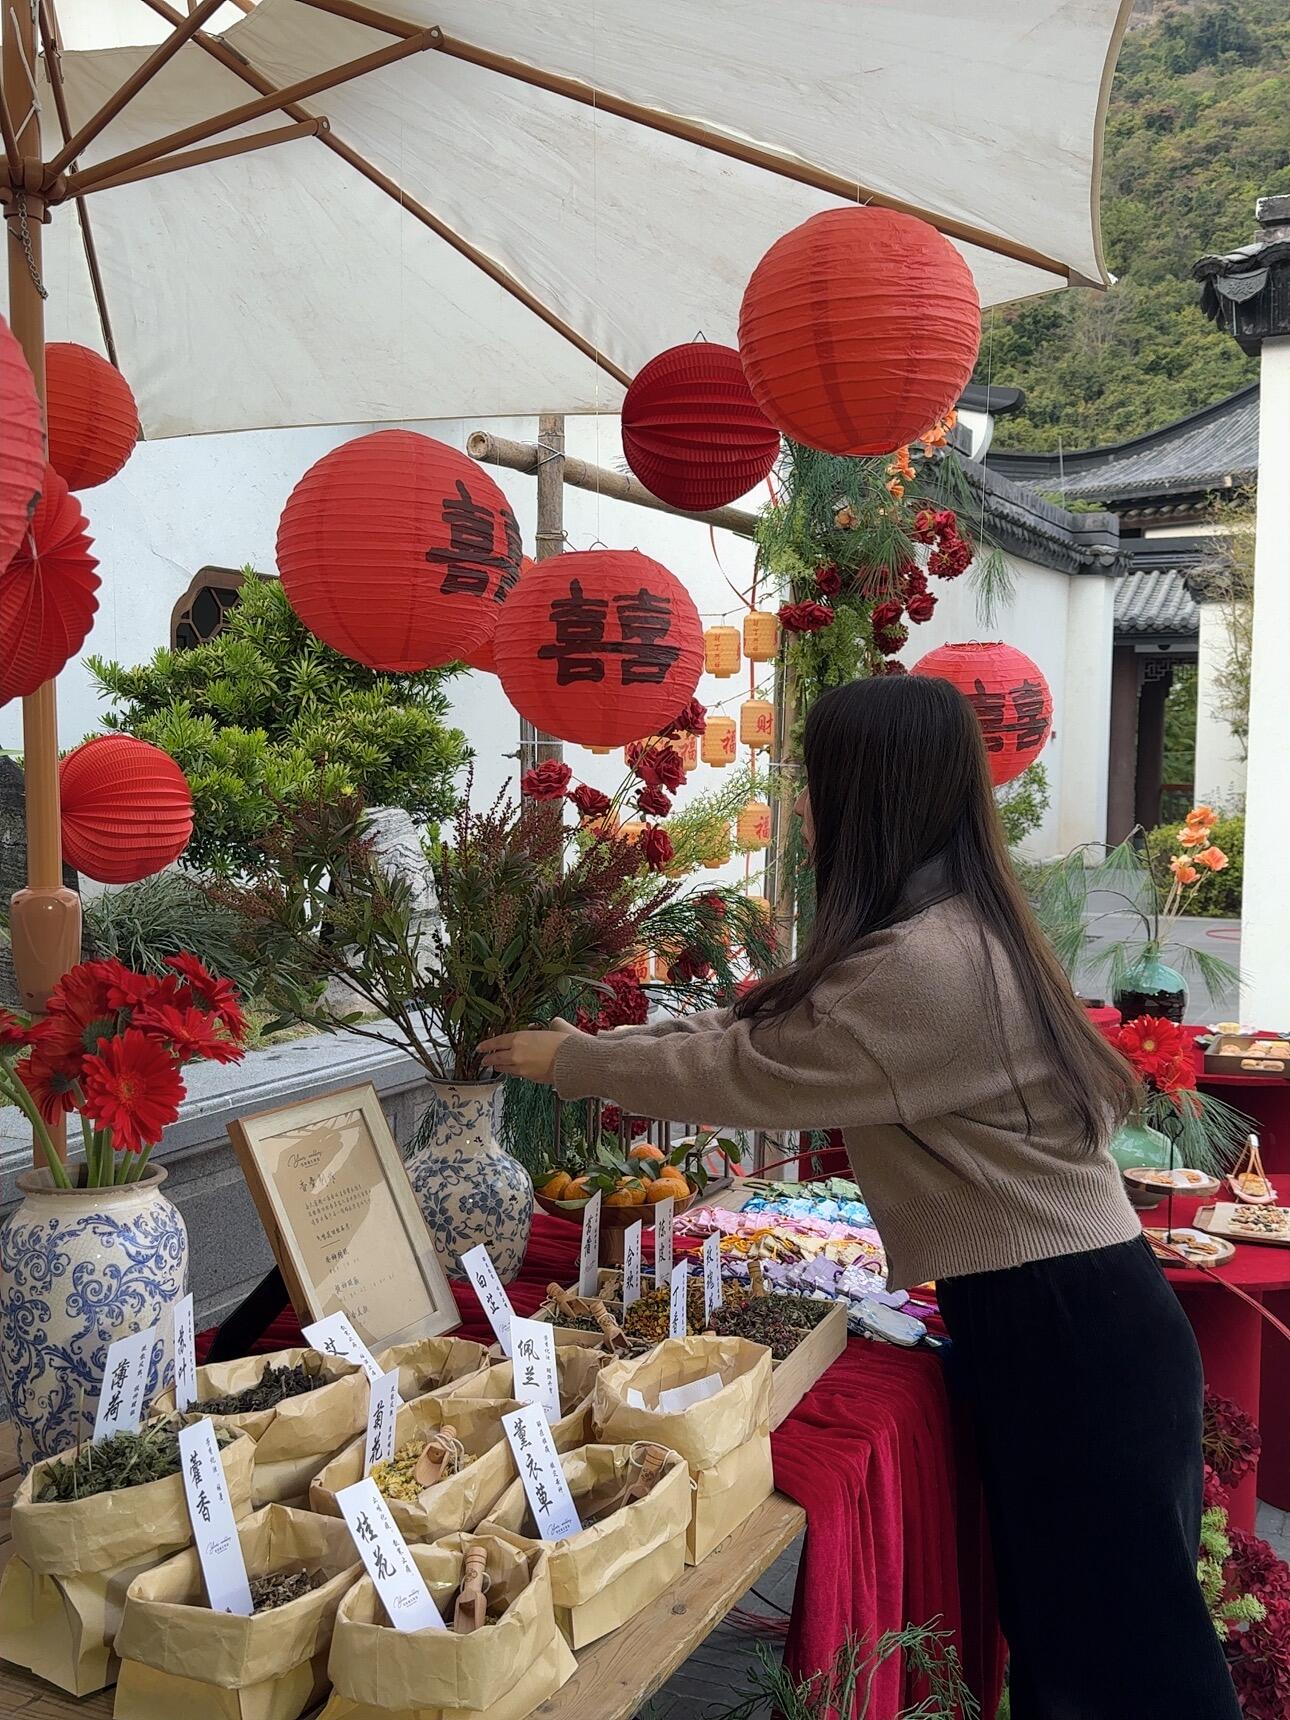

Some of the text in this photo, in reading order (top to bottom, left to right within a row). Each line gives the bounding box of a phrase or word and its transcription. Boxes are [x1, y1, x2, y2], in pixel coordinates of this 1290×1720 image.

[720, 729, 736, 756] 福
[756, 712, 773, 735] 财
[753, 815, 770, 840] 福
[672, 1286, 680, 1334] 丁香
[323, 1337, 349, 1356] 艾
[517, 1338, 541, 1388] 佩兰
[103, 1358, 131, 1422] 薄荷
[369, 1400, 385, 1464] 菊花
[190, 1450, 211, 1523] 藿香
[513, 1417, 554, 1516] 薰衣草
[356, 1510, 397, 1580] 桂花
